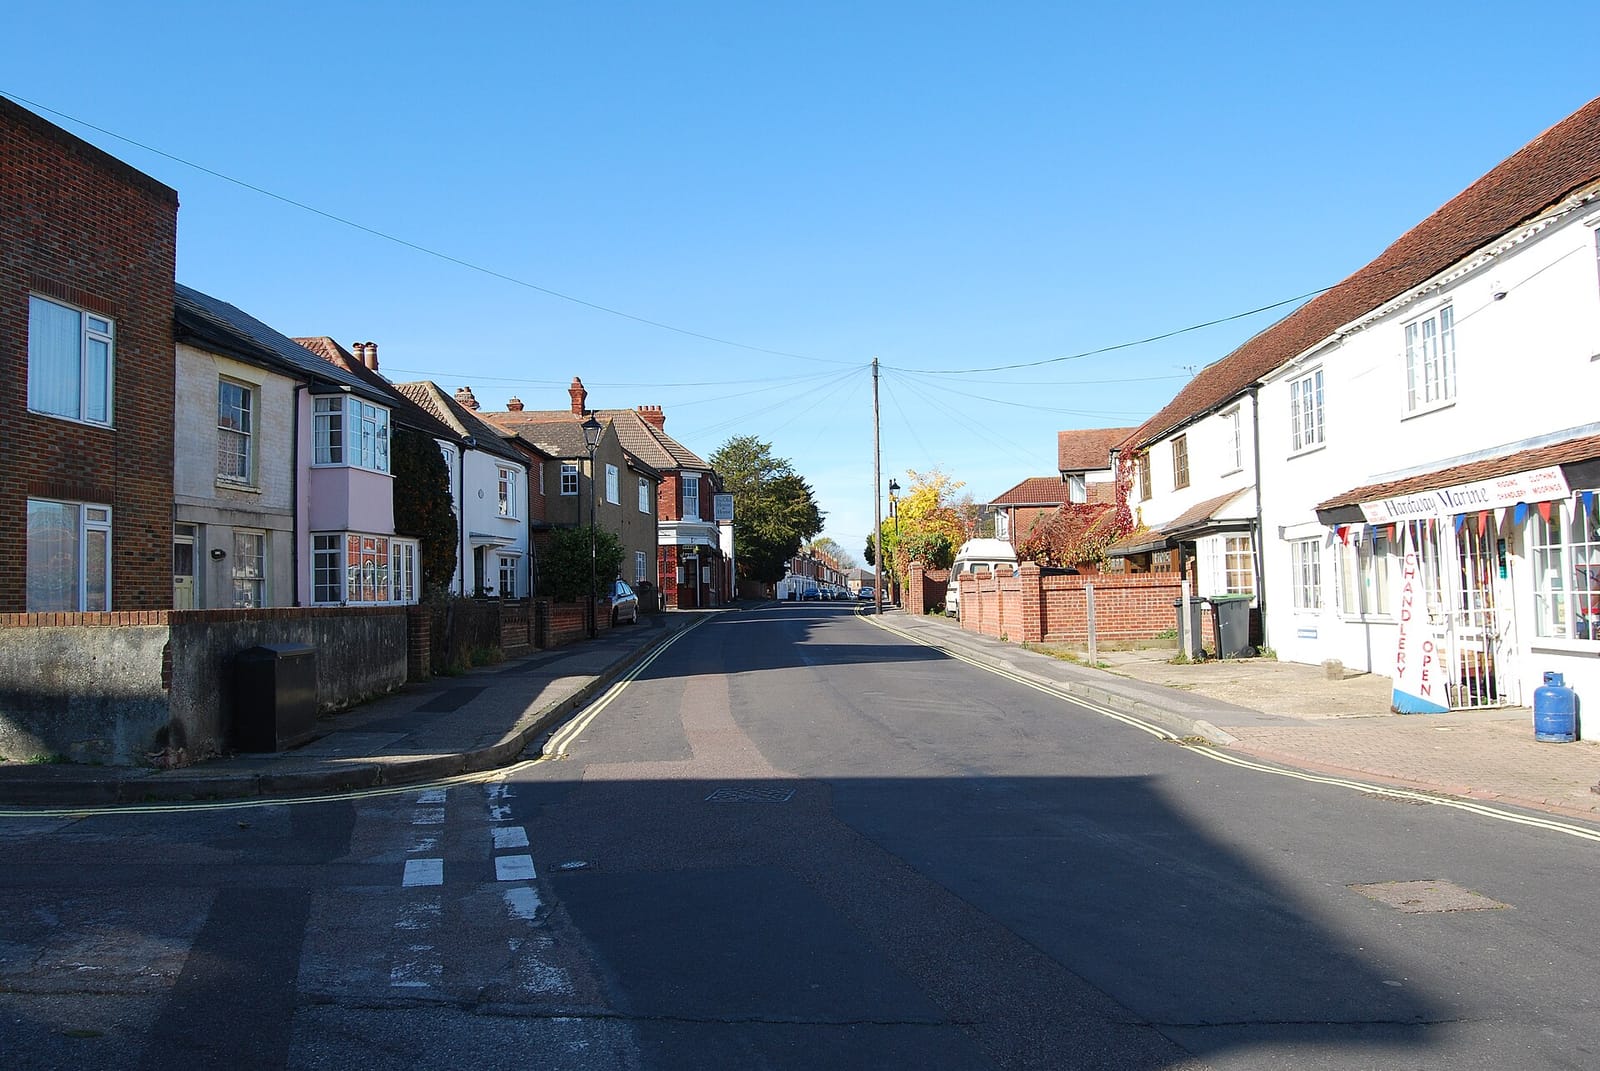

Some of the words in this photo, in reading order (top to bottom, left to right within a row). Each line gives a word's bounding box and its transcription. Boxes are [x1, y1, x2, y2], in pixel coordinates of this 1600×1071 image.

[1497, 489, 1526, 500] CHANDLERY
[1532, 483, 1562, 495] MOORINGS
[1529, 471, 1557, 483] CLOTHING
[1383, 496, 1438, 516] Hardway
[1437, 486, 1489, 508] Marine
[1397, 554, 1415, 678] CHANDLERY
[1421, 641, 1434, 696] OPEN
